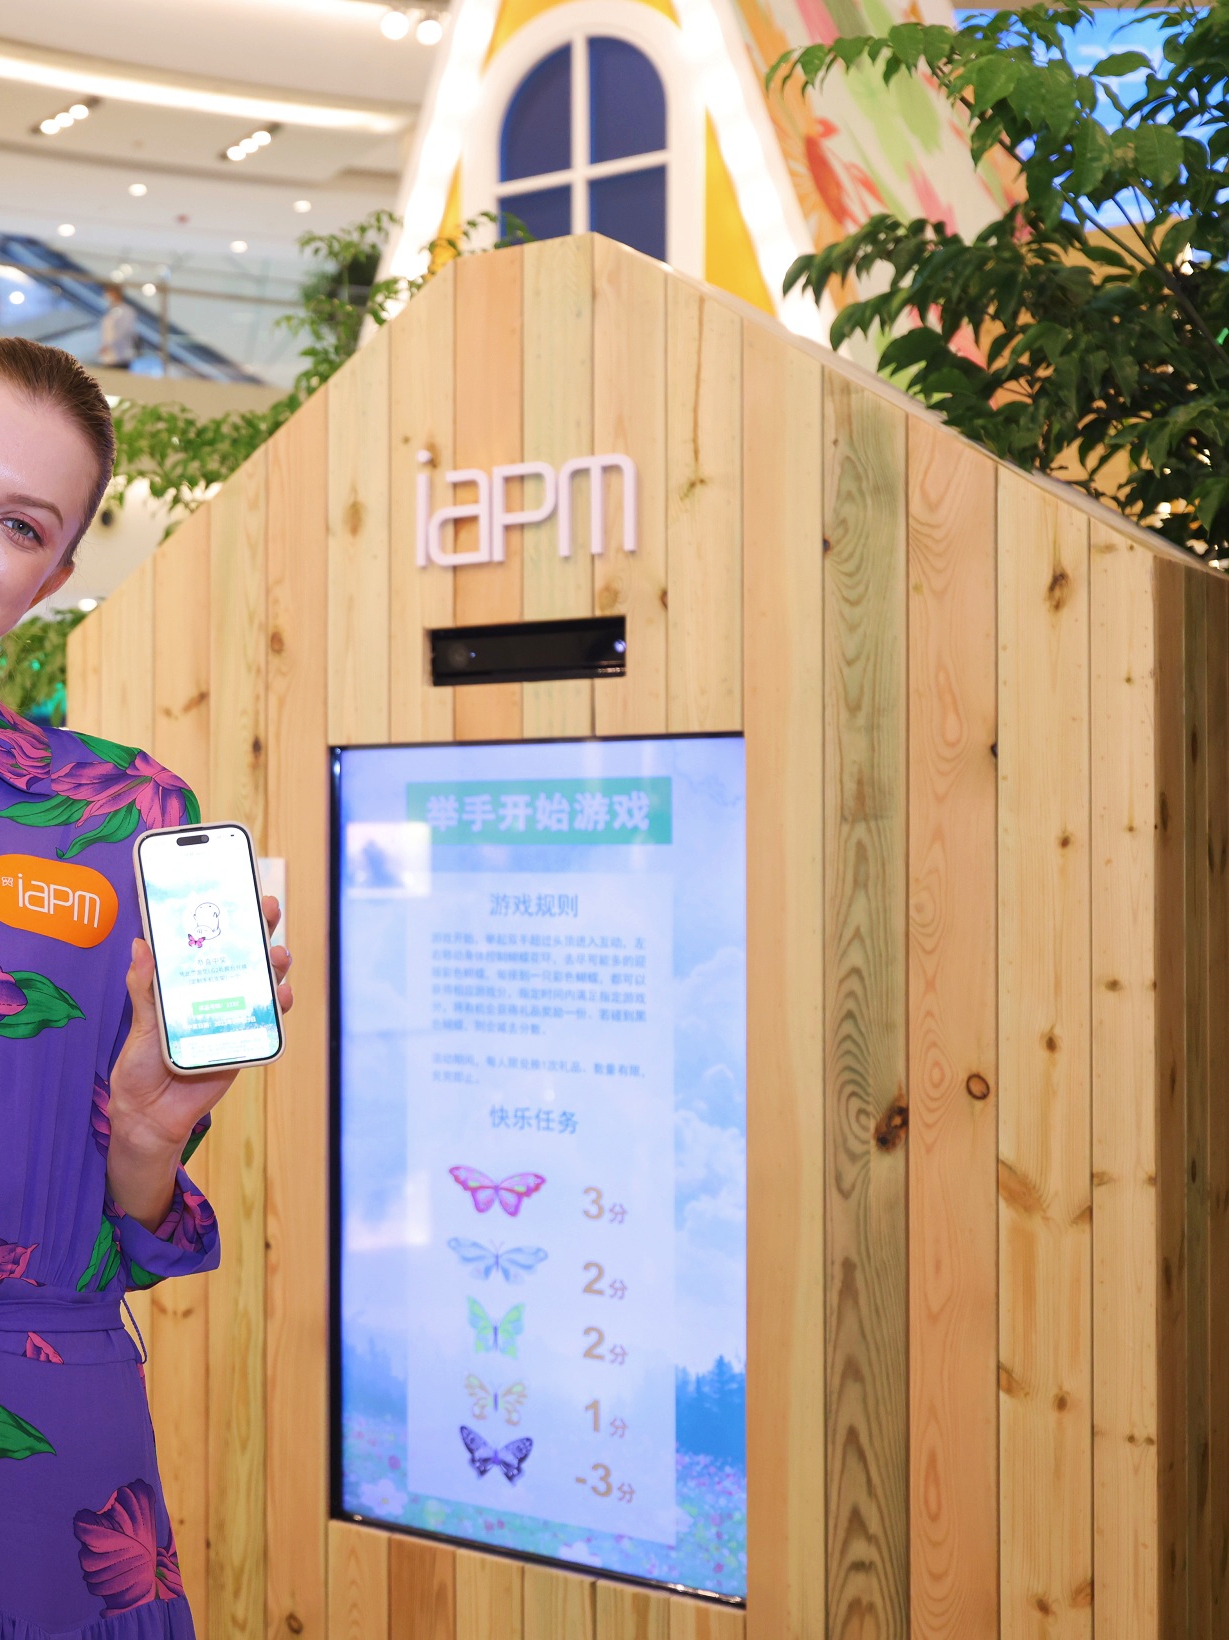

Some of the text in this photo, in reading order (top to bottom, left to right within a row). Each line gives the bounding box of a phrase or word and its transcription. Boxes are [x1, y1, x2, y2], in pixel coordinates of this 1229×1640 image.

[416, 449, 637, 568] iapm
[426, 790, 651, 833] 举手开始游戏
[17, 873, 101, 929] iapm
[489, 893, 579, 919] 游戏规则
[489, 1105, 579, 1134] 快乐任务
